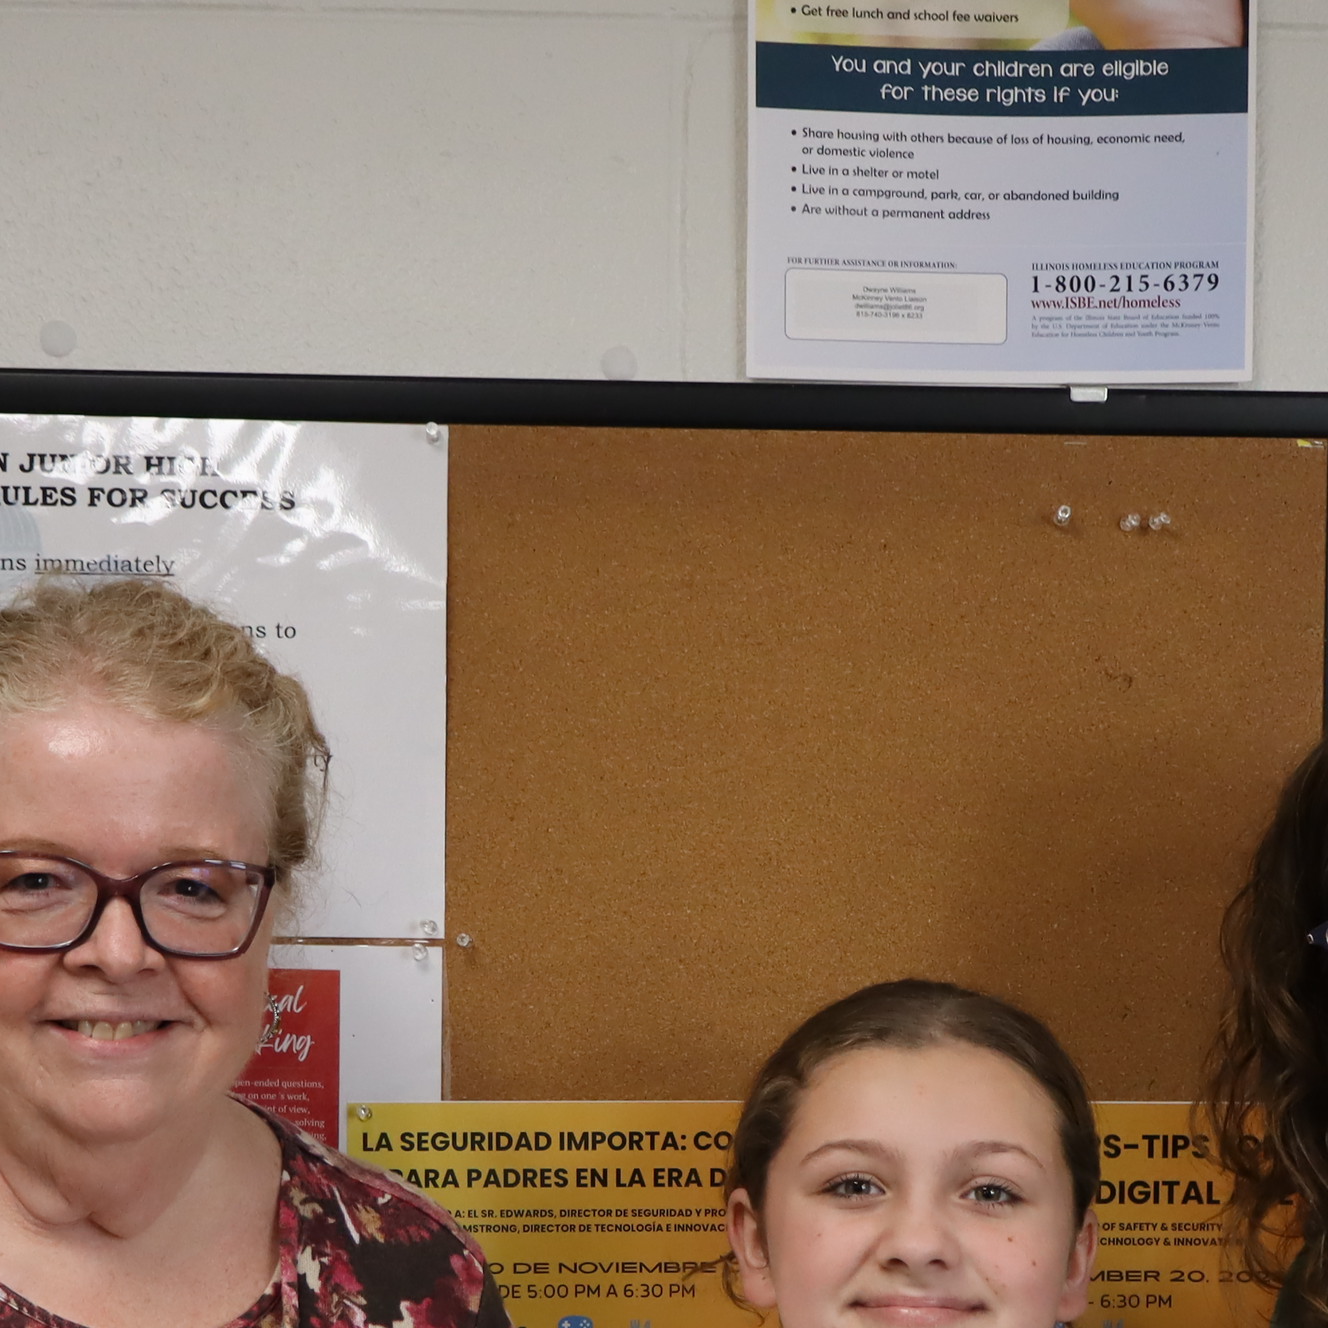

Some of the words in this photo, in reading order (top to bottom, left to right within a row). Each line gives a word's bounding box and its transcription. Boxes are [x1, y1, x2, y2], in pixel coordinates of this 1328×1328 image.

[831, 54, 866, 73] You
[873, 58, 911, 75] and
[918, 61, 966, 79] your
[972, 60, 1053, 77] children
[1059, 62, 1095, 77] are
[1102, 59, 1169, 80] eligible
[879, 83, 914, 100] for
[921, 84, 979, 102] these
[986, 85, 1046, 107] rights
[1053, 85, 1071, 103] if
[1077, 88, 1119, 106] you:
[1031, 262, 1070, 271] ILLINOIS
[1071, 262, 1118, 271] HOMELESS
[1120, 261, 1172, 270] EDUCATION
[1174, 260, 1219, 269] PROGRAM
[1032, 273, 1219, 293] 1-800-215-6379
[1031, 294, 1181, 310] www.ISBE.net/homeless
[87, 486, 149, 508] FOR
[35, 553, 175, 576] immediately
[362, 1132, 393, 1152] LA
[400, 1131, 552, 1152] SEGURIDAD
[559, 1131, 687, 1151] IMPORTA:
[467, 1167, 568, 1188] PADRES
[576, 1167, 608, 1188] EN
[615, 1167, 646, 1188] LA
[653, 1167, 703, 1188] ERA
[1096, 1181, 1220, 1205] DIGITAL
[1102, 1222, 1116, 1231] OF
[1118, 1222, 1158, 1232] SAFETY
[1160, 1222, 1168, 1232] &
[527, 1283, 569, 1299] 5:00
[574, 1283, 600, 1298] PM
[605, 1283, 618, 1298] A
[623, 1283, 663, 1298] 6:30
[669, 1283, 696, 1298] PM
